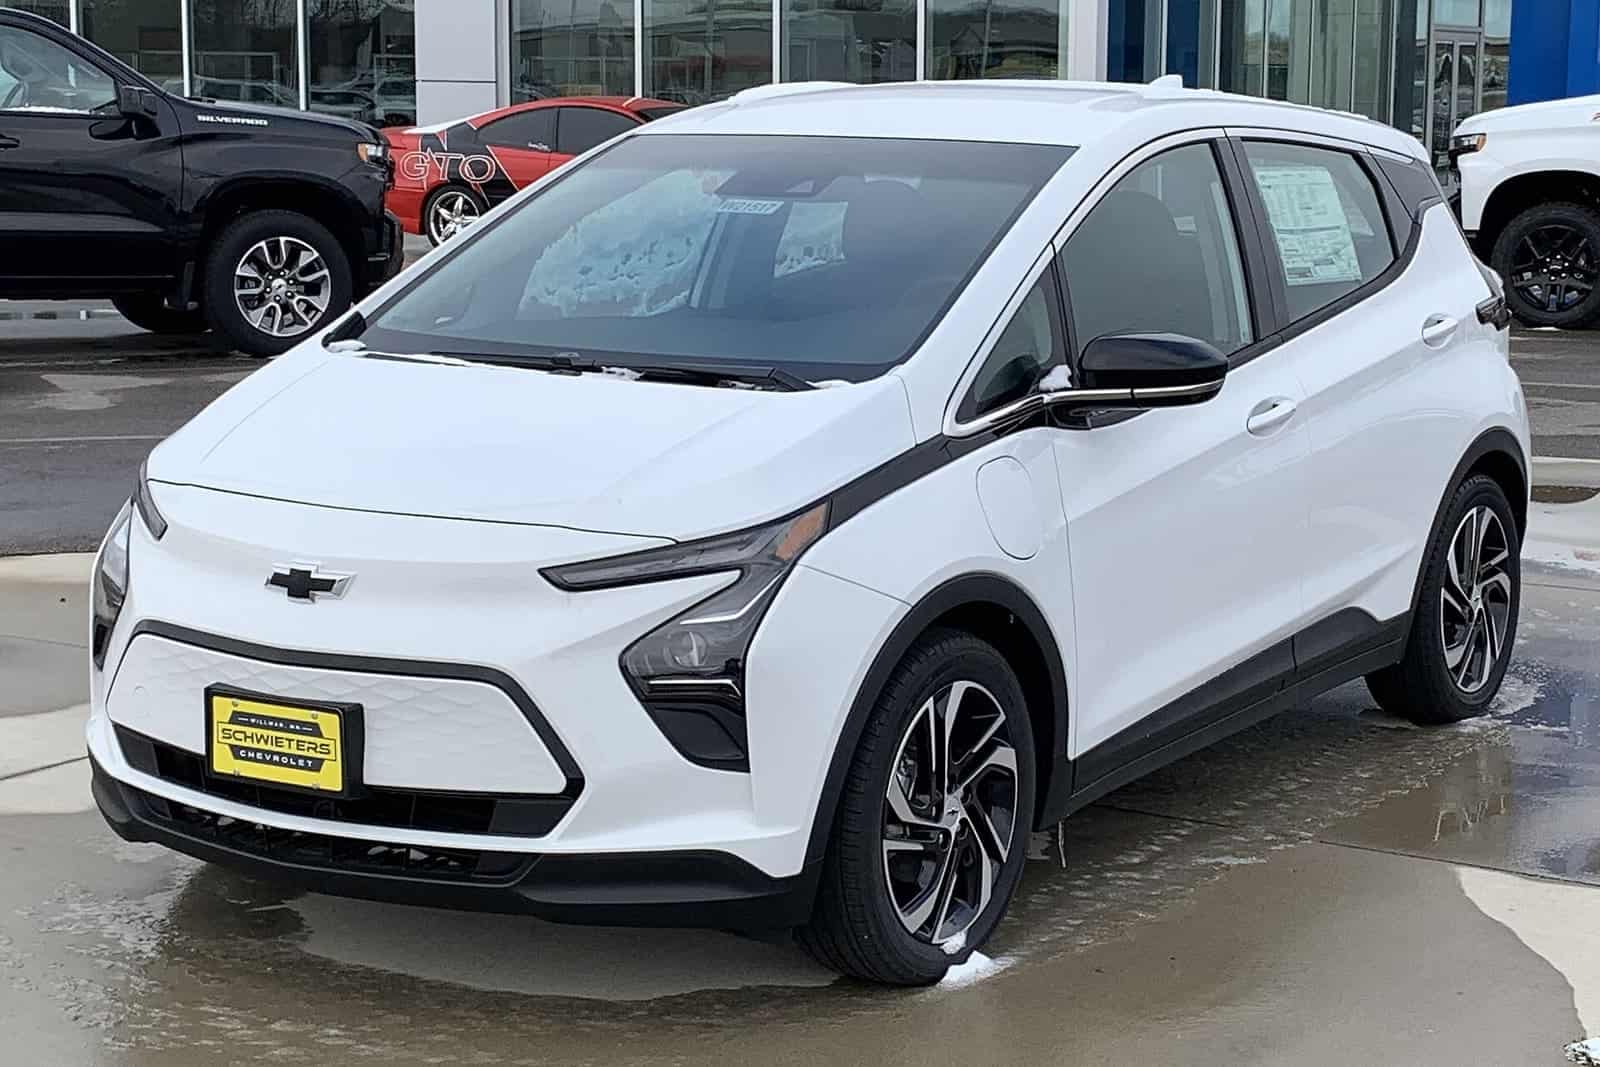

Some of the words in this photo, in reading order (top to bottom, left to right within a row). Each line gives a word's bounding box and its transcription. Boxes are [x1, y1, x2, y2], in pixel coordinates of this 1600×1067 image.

[196, 115, 268, 126] SILVERADO
[400, 151, 496, 184] GTO
[222, 728, 330, 755] SCHWIETERS
[239, 749, 313, 767] CHEVROLET
